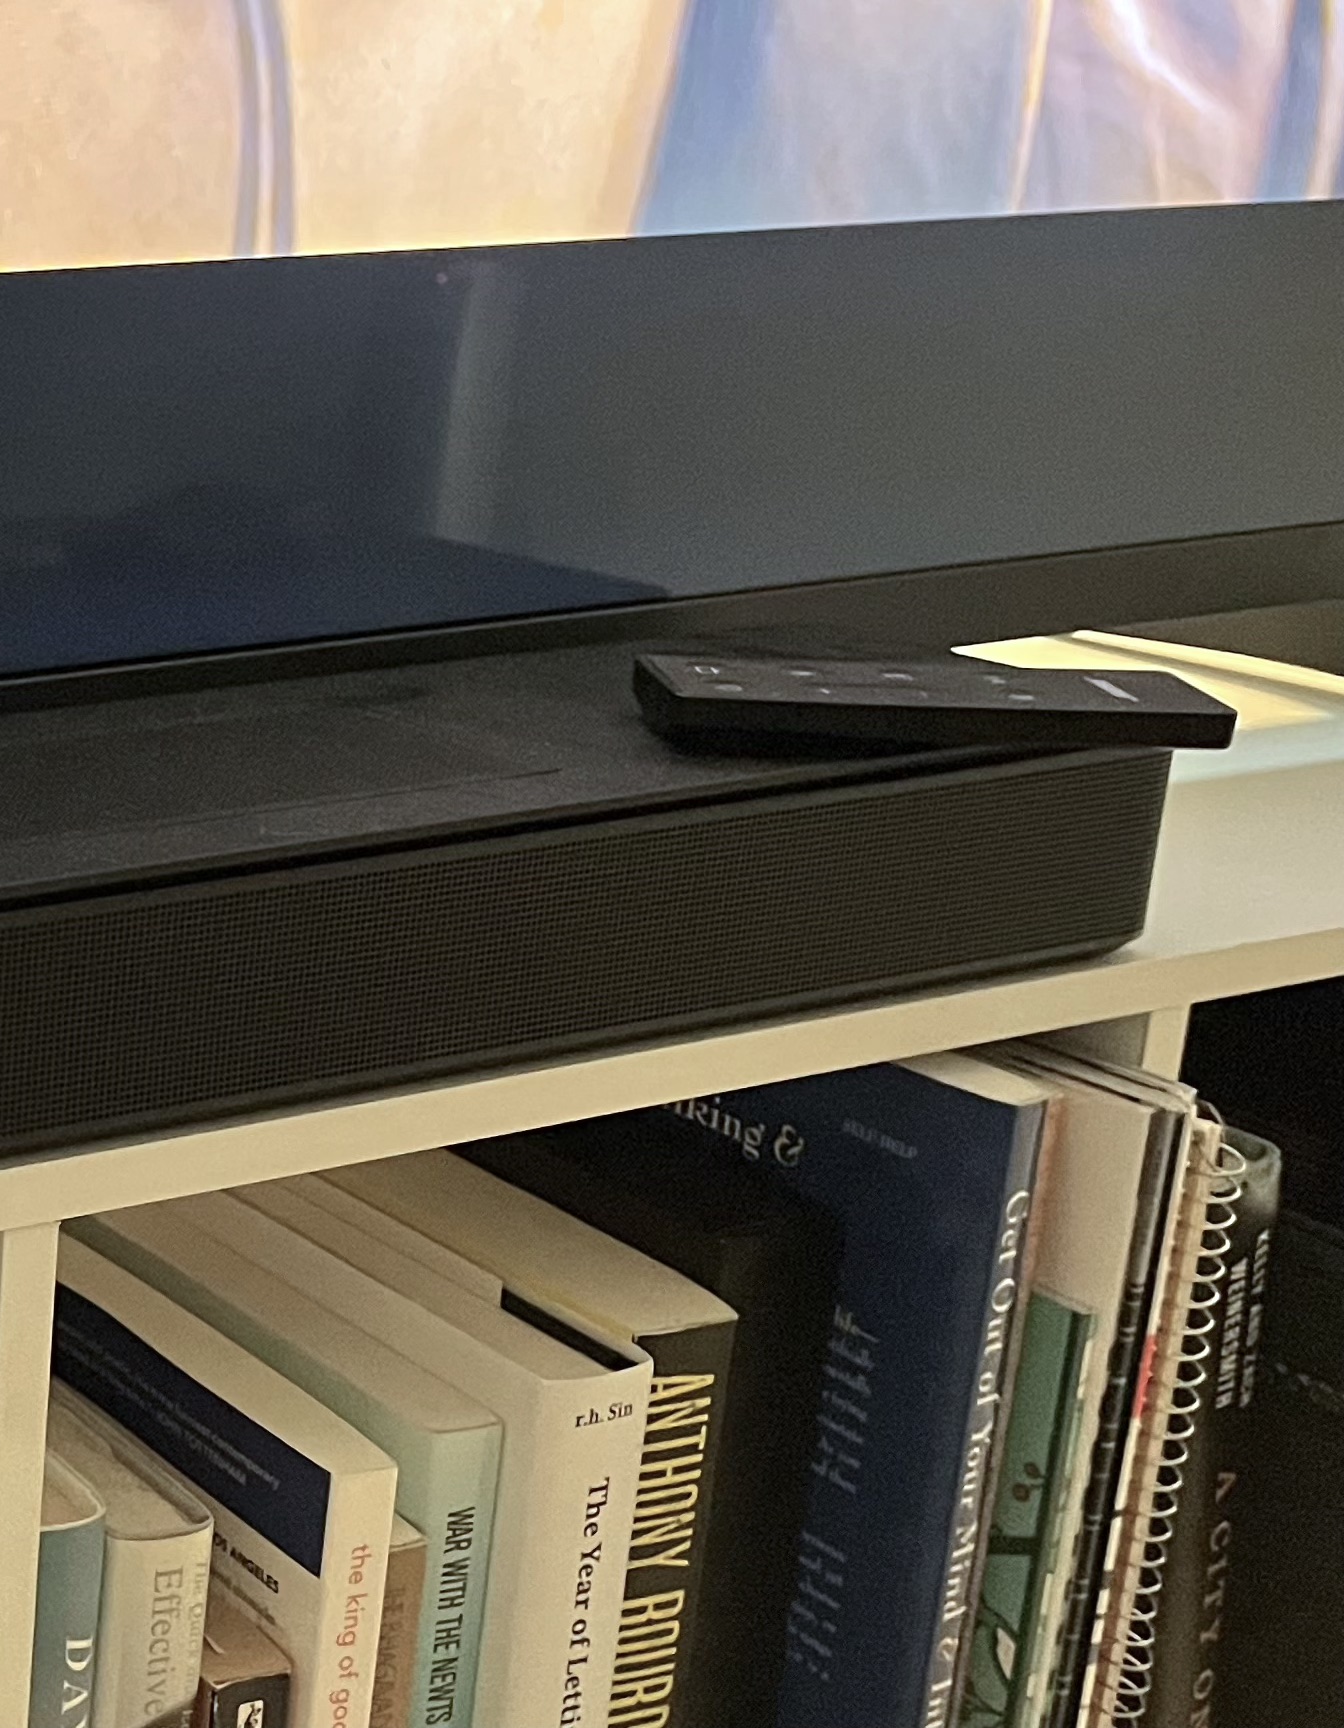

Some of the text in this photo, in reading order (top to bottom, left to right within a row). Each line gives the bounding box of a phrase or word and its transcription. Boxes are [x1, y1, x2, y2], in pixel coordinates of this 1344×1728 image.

[774, 1124, 805, 1168] &
[997, 1189, 1030, 1265] Get
[984, 1276, 1016, 1356] Out
[574, 1400, 634, 1428] r.h. Sin
[976, 1371, 1001, 1406] of
[960, 1419, 993, 1508] Your
[213, 1531, 280, 1595] OS ANGELES
[347, 1544, 373, 1585] the
[607, 1374, 715, 1728] ANTHONY BOURD
[943, 1518, 980, 1622] Mind
[335, 1592, 369, 1647] king
[425, 1505, 476, 1726] WAR WITH THE NEWTS
[560, 1476, 611, 1728] The Year of Letti
[143, 1565, 184, 1718] Effective
[337, 1655, 360, 1679] of
